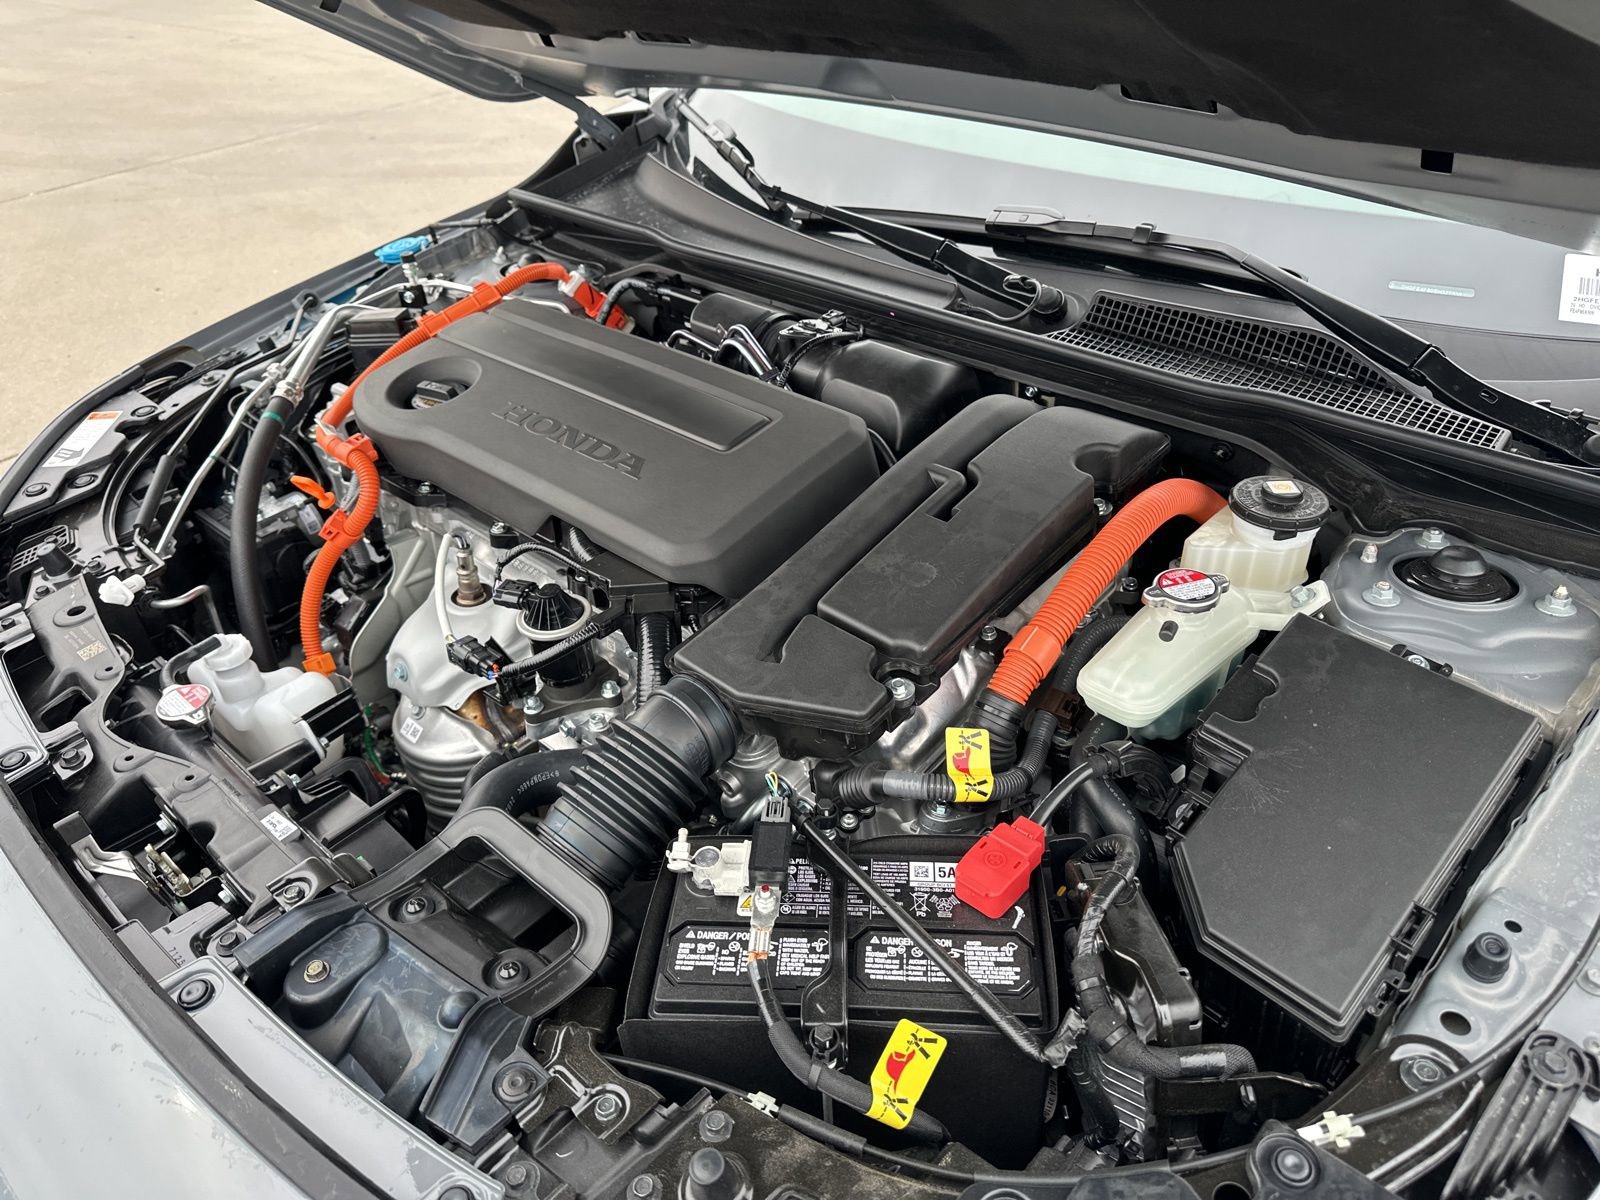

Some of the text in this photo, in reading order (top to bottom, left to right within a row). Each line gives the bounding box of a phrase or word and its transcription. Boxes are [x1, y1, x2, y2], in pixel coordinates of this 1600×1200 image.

[491, 401, 645, 480] HONDA
[697, 930, 751, 940] DANGER/POI
[933, 938, 953, 947] SON
